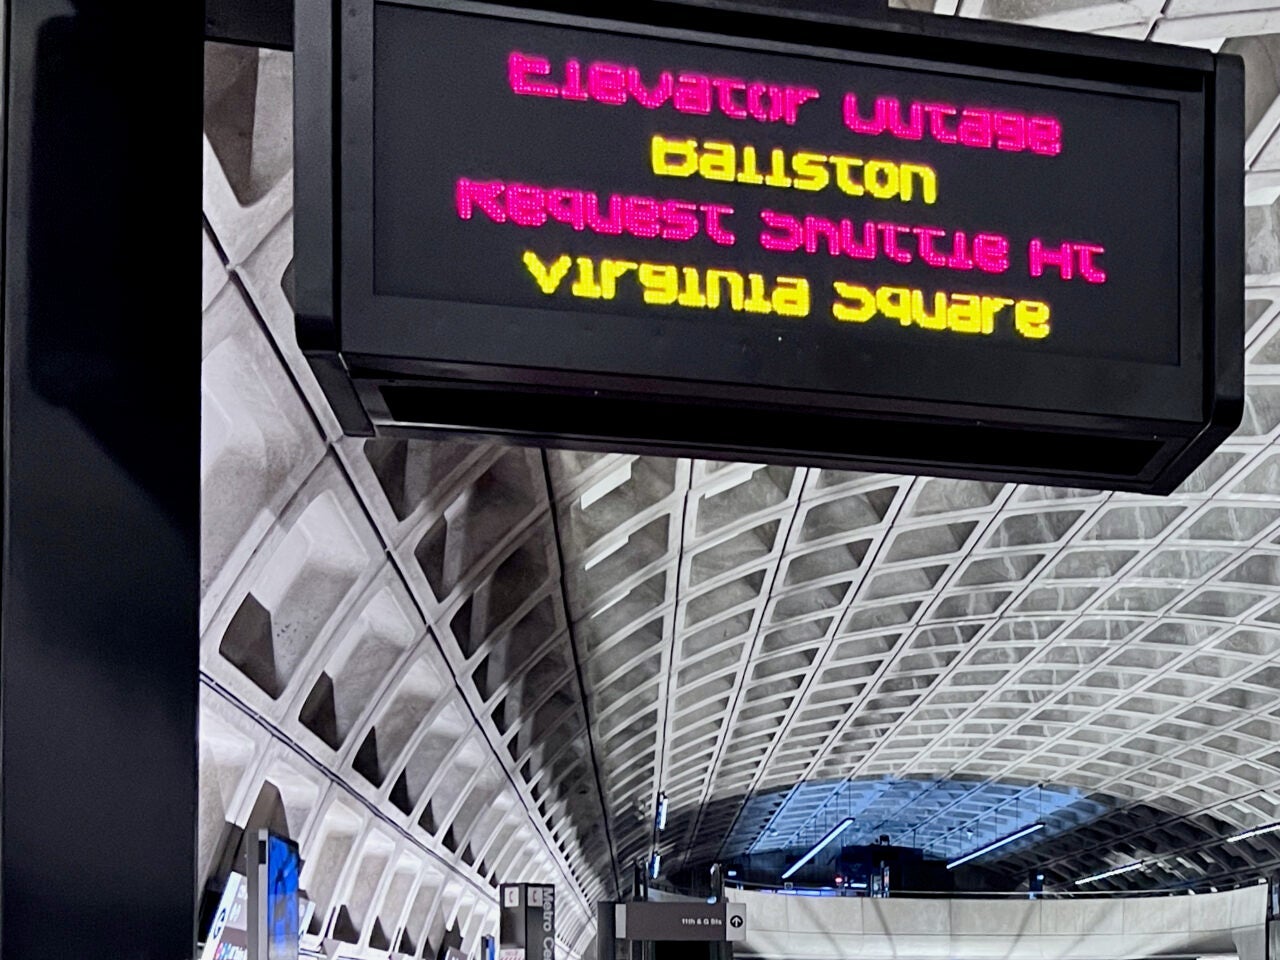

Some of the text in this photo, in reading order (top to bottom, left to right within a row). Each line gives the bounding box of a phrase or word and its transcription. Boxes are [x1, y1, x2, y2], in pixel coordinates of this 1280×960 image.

[508, 51, 1062, 156] Elevator Outage
[650, 135, 937, 205] Ballston
[456, 177, 736, 247] Request
[760, 209, 1010, 274] Shuttle
[522, 250, 1051, 339] Virginia Square
[542, 887, 554, 932] Metro
